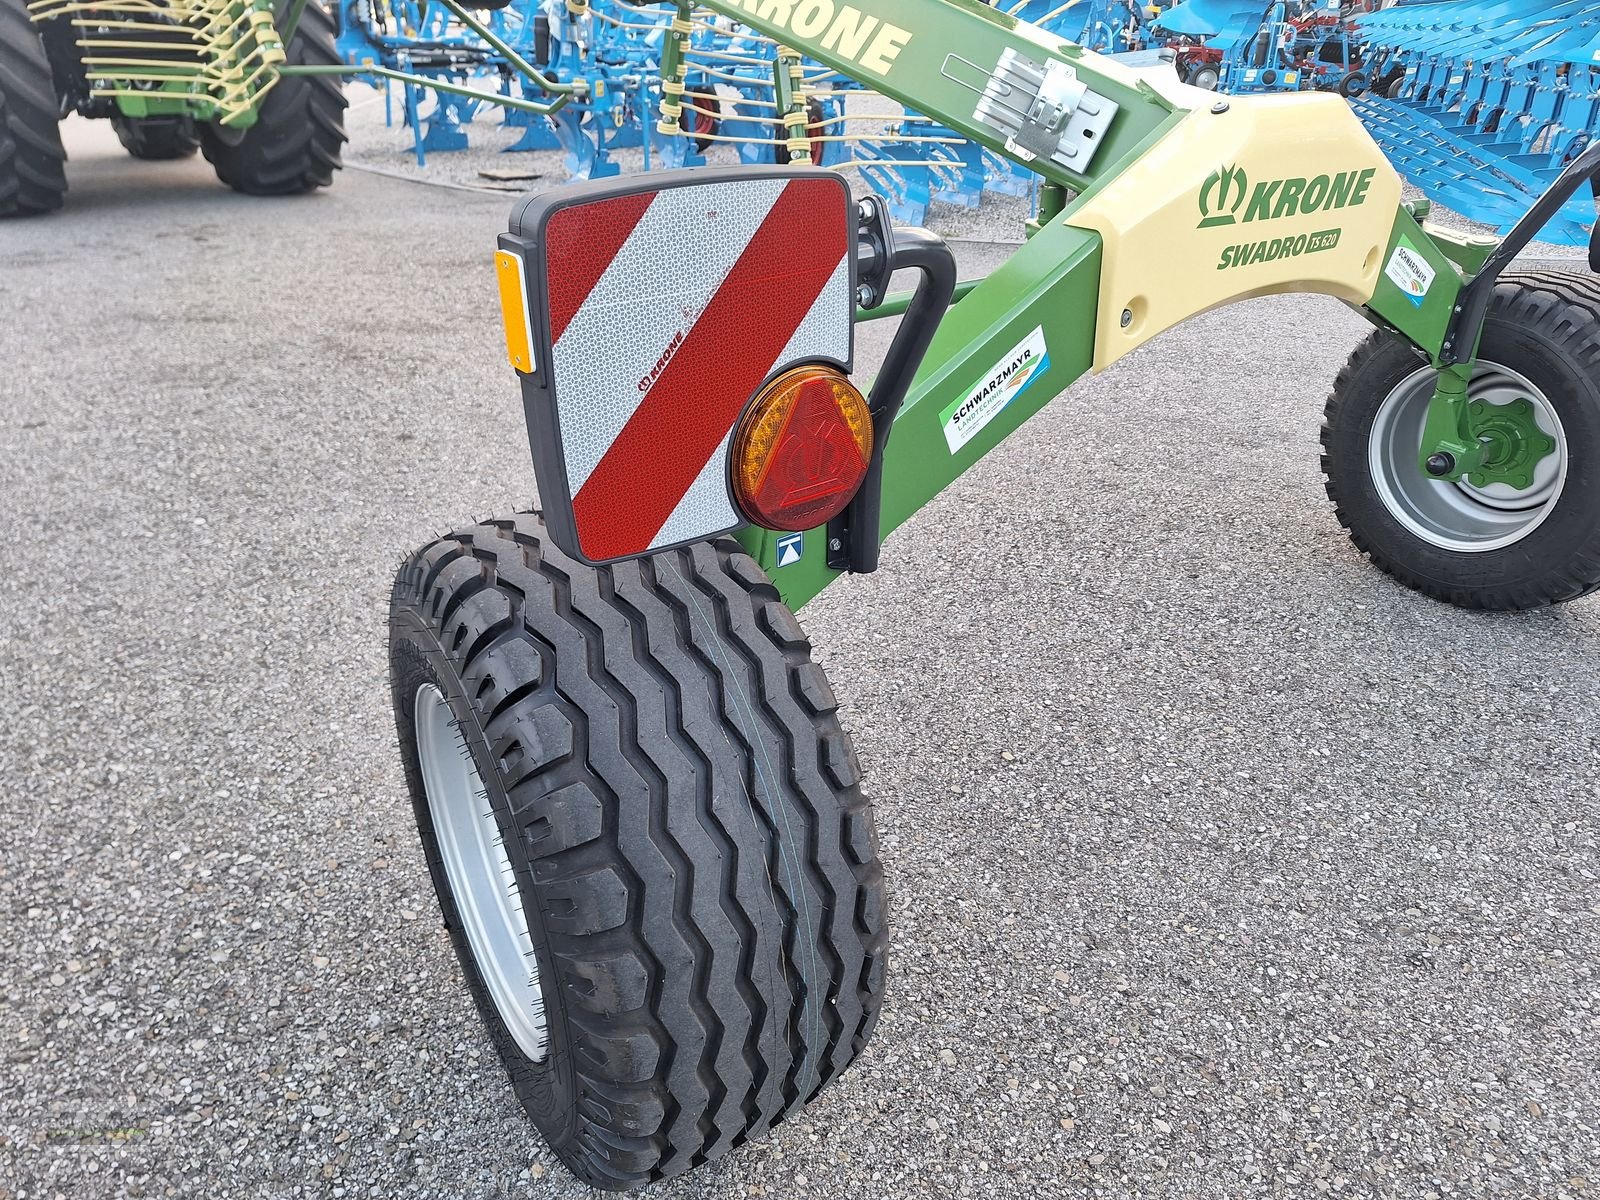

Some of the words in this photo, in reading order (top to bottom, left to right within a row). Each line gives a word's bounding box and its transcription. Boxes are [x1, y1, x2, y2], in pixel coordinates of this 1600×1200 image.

[726, 0, 913, 76] RONE
[1242, 168, 1376, 223] KRONE
[1217, 234, 1307, 270] SWADRO
[1310, 236, 1322, 249] TS
[1321, 234, 1337, 247] 620
[651, 331, 684, 380] KRONE
[952, 349, 1032, 424] SCHWARZMAYR
[957, 388, 1004, 432] LANDTECHNIK
